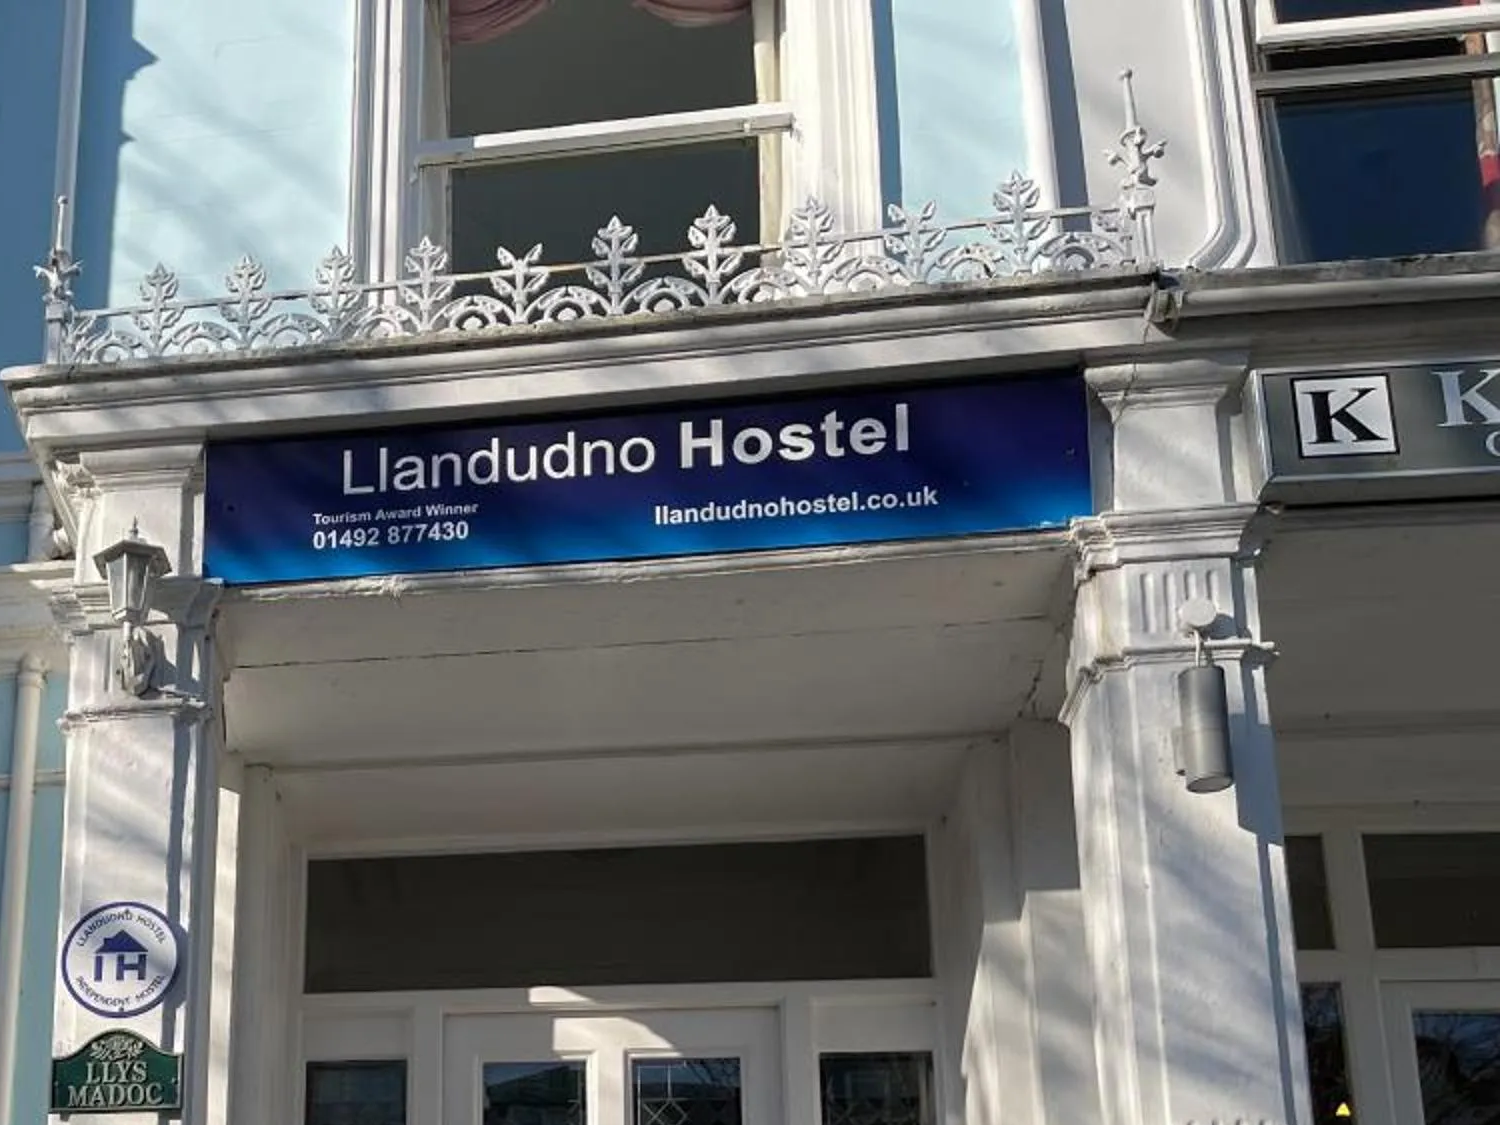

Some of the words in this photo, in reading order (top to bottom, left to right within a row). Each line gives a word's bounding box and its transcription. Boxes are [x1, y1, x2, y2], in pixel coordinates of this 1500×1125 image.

[1301, 386, 1389, 445] K
[342, 431, 656, 496] Llandudno
[679, 402, 909, 469] Hostel
[312, 511, 372, 526] Tourism
[375, 505, 422, 522] Award
[426, 502, 480, 518] Winner
[654, 485, 940, 526] llandudnohostel.co.uk
[312, 527, 381, 550] 01492
[386, 520, 470, 545] 877430
[86, 1060, 148, 1085] LLYS
[67, 1082, 164, 1108] MADOC
